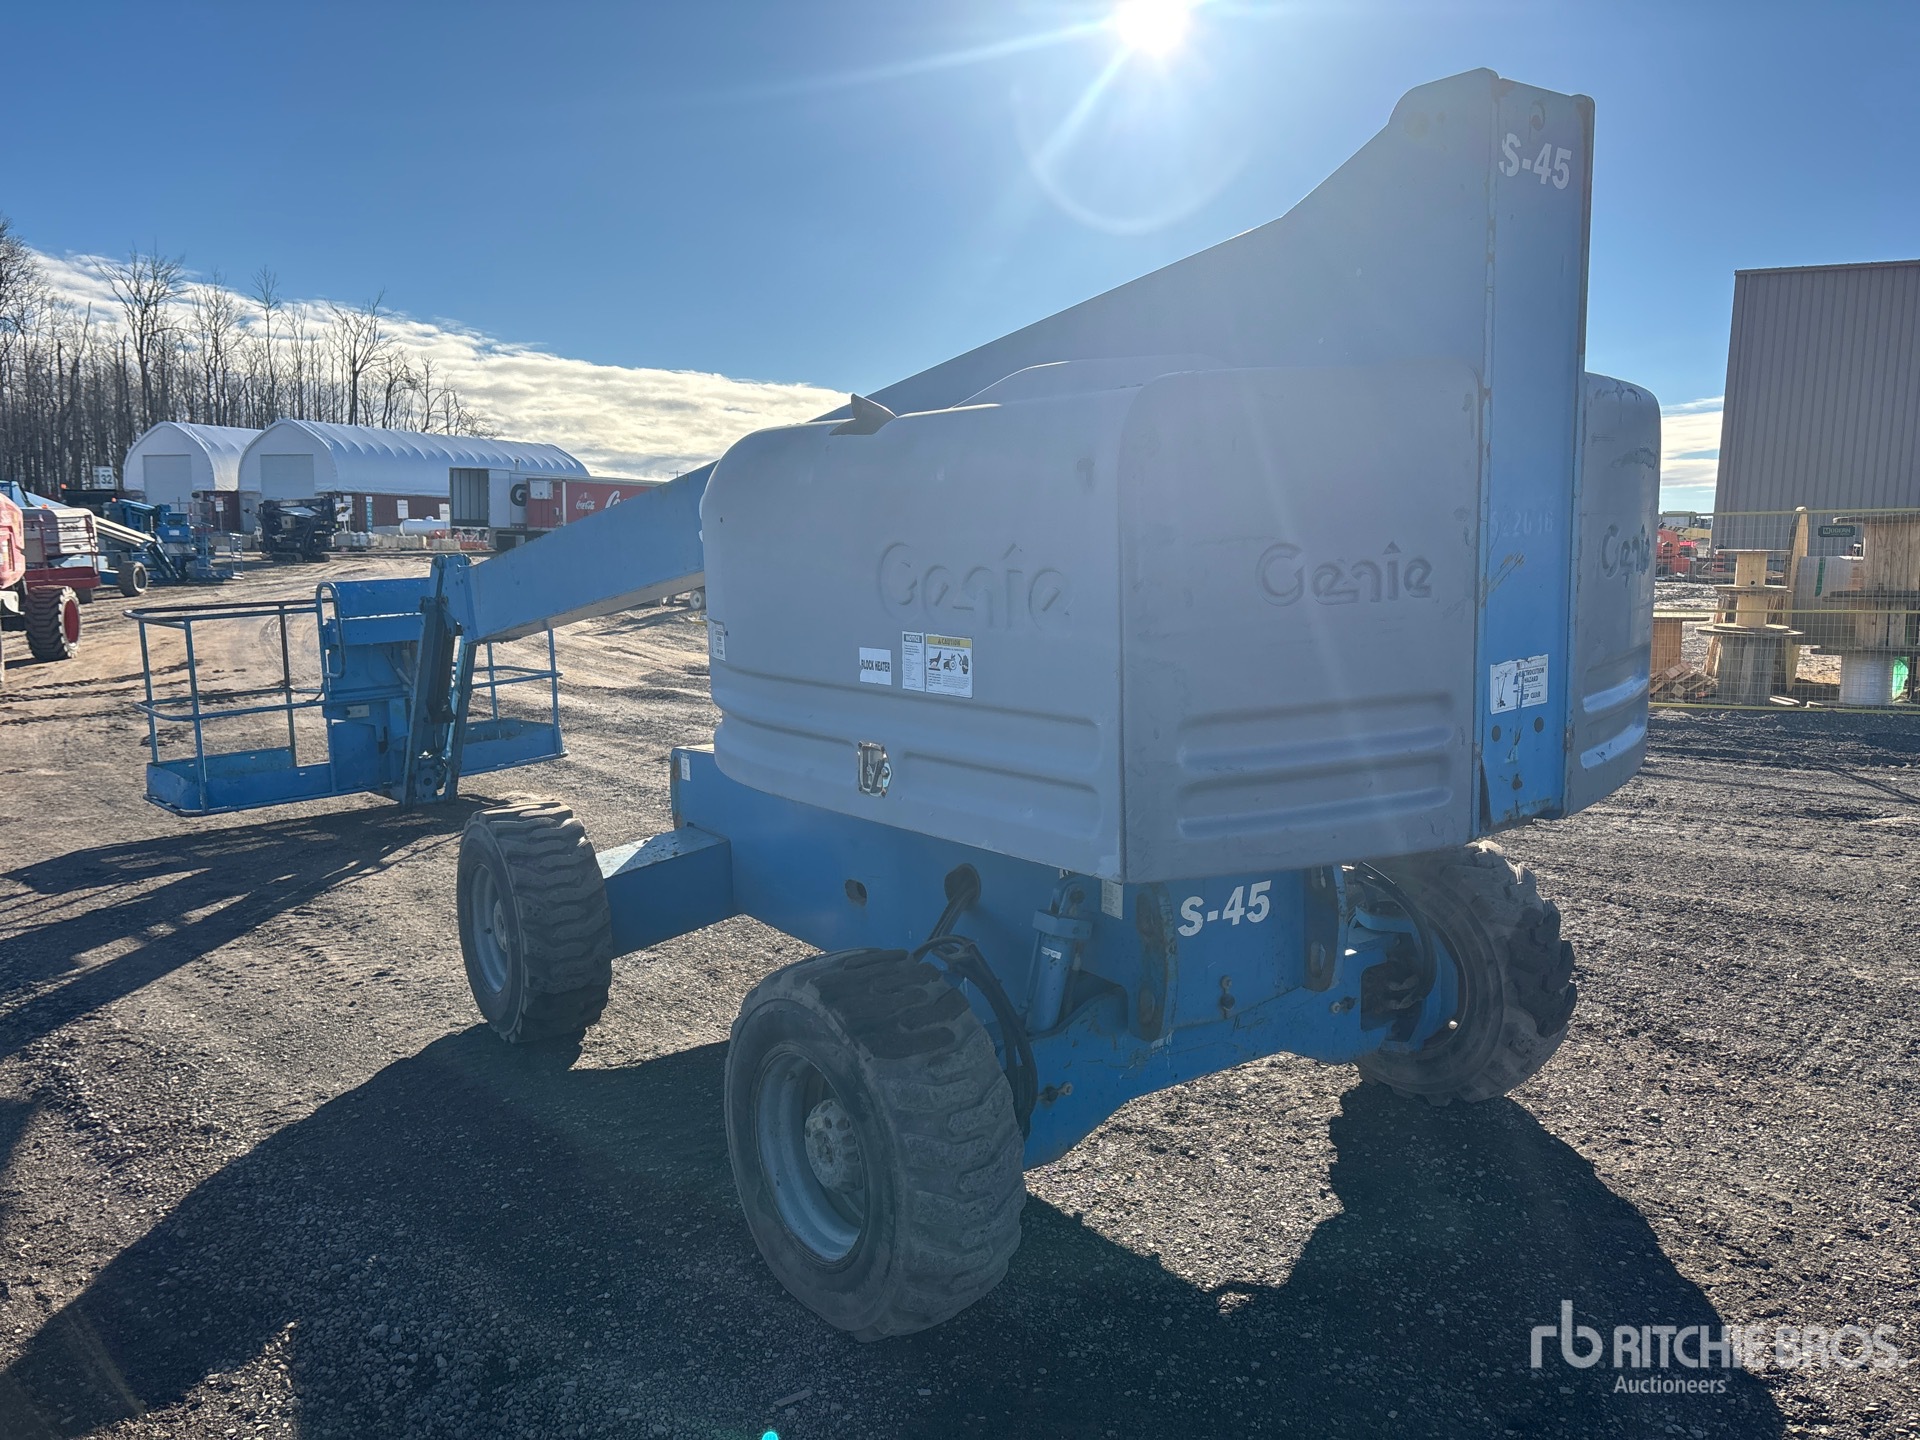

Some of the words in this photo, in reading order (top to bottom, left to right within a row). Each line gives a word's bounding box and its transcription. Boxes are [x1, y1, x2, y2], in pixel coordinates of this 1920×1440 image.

[1499, 132, 1572, 190] S-45
[101, 474, 113, 485] 32
[877, 541, 1073, 632] Genie
[1254, 541, 1433, 607] Genie
[905, 634, 921, 643] NOTICE
[942, 638, 961, 647] CAUTION
[861, 659, 875, 671] BLOCK
[875, 660, 891, 673] HEATER
[1177, 880, 1272, 937] S-45
